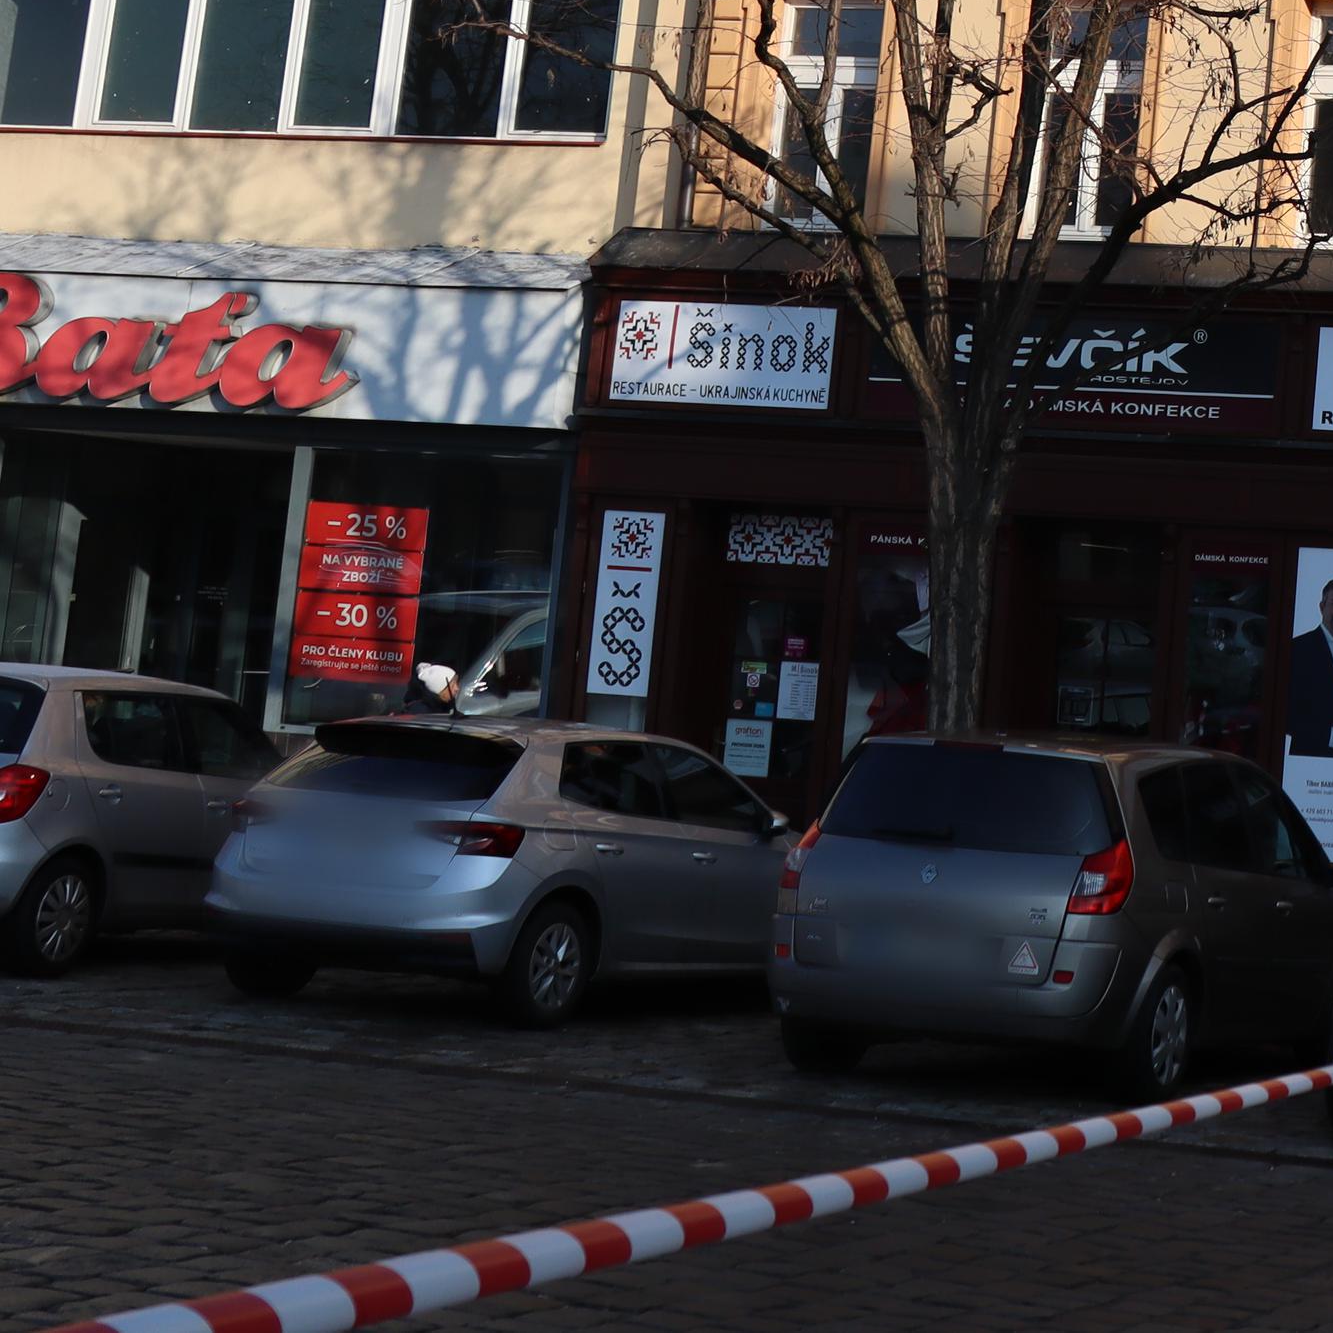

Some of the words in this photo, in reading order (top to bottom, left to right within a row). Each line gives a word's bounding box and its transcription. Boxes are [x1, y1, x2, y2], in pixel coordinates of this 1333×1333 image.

[687, 307, 831, 374] Šinok
[612, 381, 687, 397] RESTAURACE
[699, 384, 770, 401] UKRAJINSKÁ
[773, 387, 826, 404] KUCHYNĚ
[1027, 396, 1105, 414] MSKÁ
[1110, 401, 1220, 420] KONFEKCE
[870, 533, 913, 545] PÁNSKÁ
[322, 554, 341, 566] NA
[344, 555, 404, 570] VYBRANÉ
[1194, 552, 1226, 562] DÁMSKÁ
[1228, 555, 1270, 565] KONFEKCE
[302, 645, 325, 657] PRO
[327, 644, 365, 659] ČLENY
[366, 651, 404, 663] KLUBU
